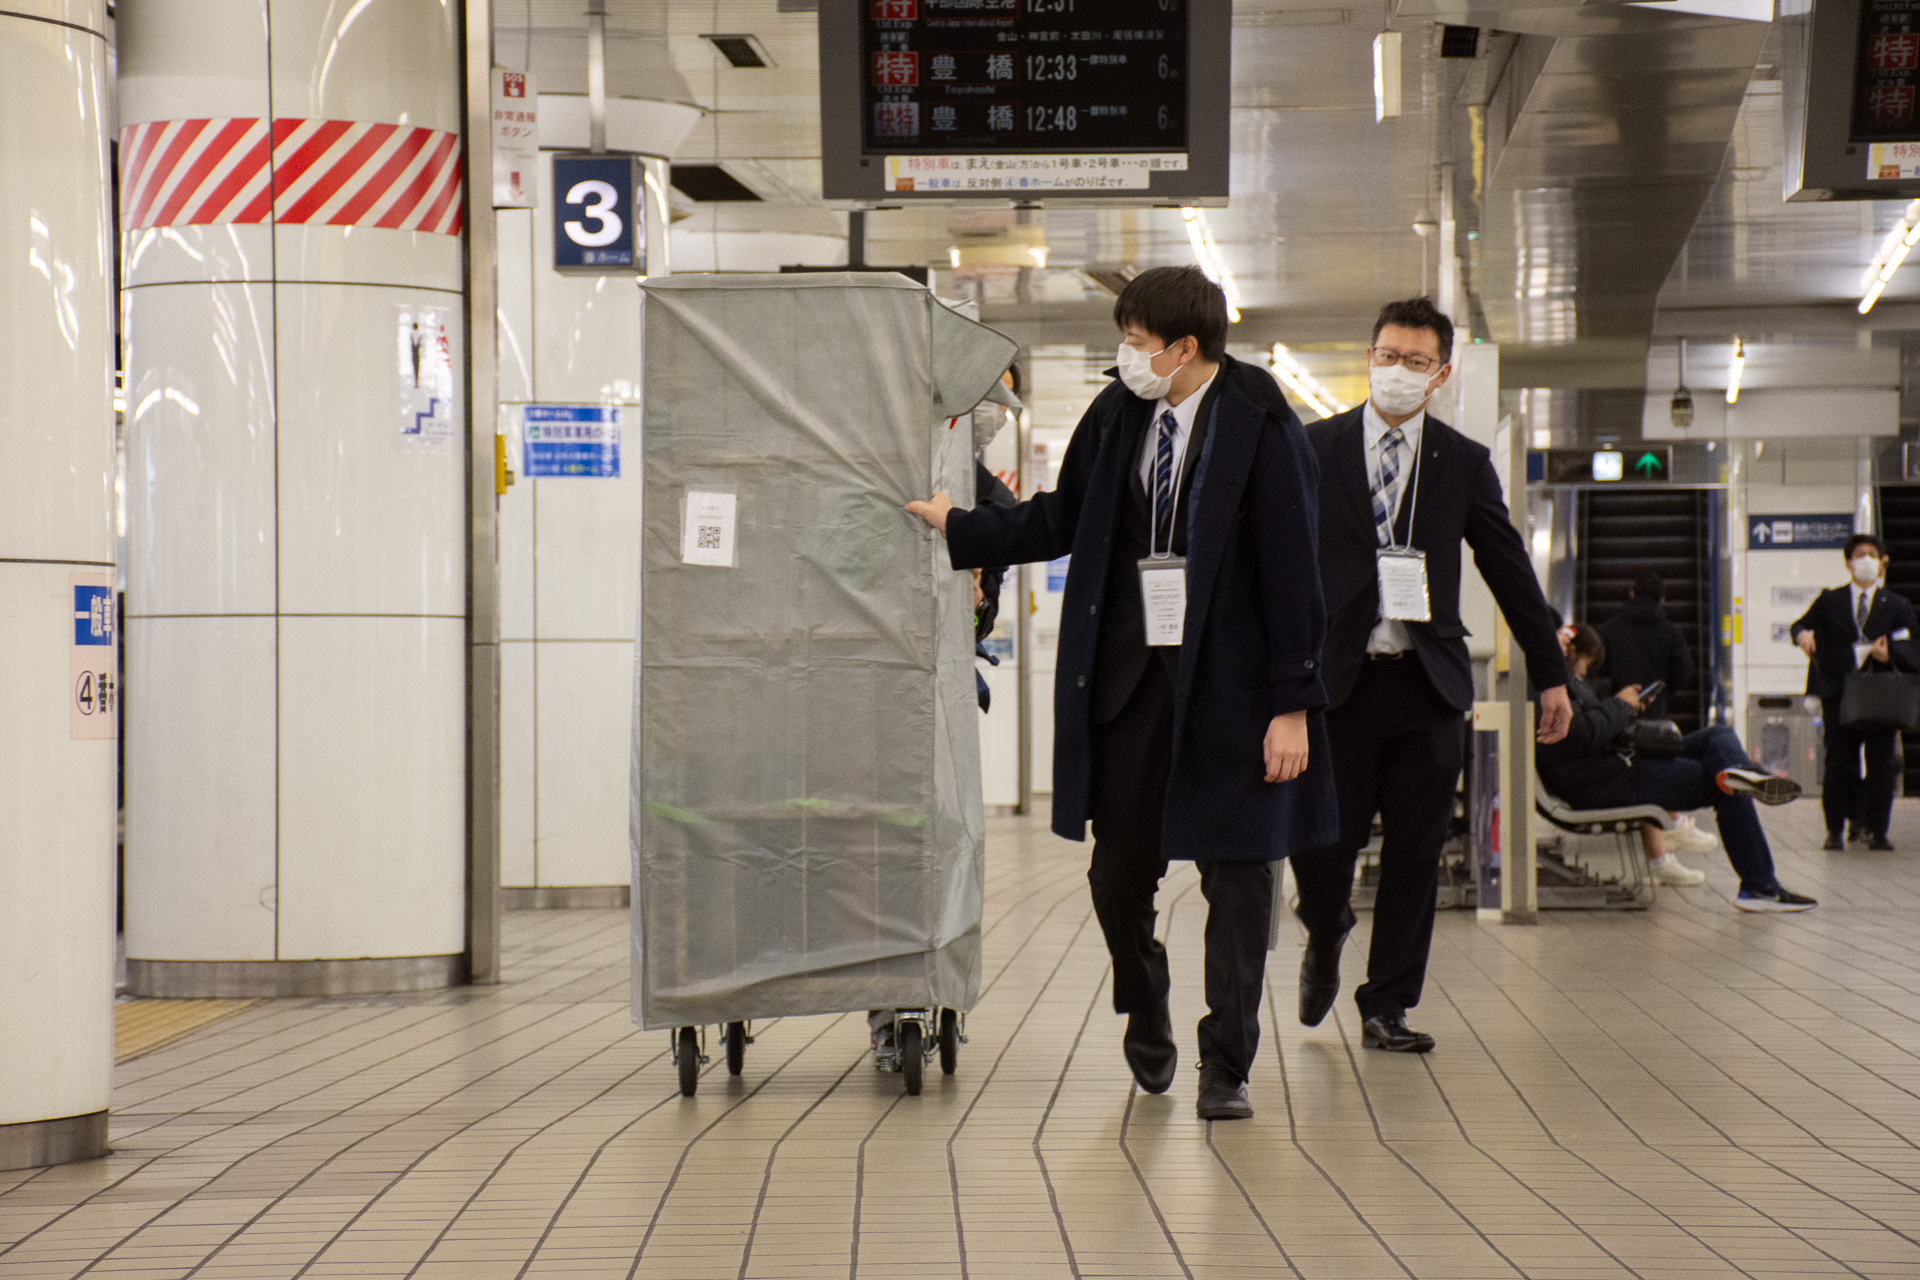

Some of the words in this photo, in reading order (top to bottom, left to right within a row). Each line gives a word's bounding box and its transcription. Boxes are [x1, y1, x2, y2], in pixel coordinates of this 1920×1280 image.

[1874, 37, 1914, 68] 特
[505, 73, 523, 82] SOS
[877, 53, 914, 84] 特
[1026, 55, 1077, 81] 12:33
[494, 110, 536, 123] 非常通報
[1870, 89, 1908, 119] 特
[1026, 106, 1077, 131] 12:48
[500, 126, 532, 138] ボタン
[563, 180, 623, 247] 3
